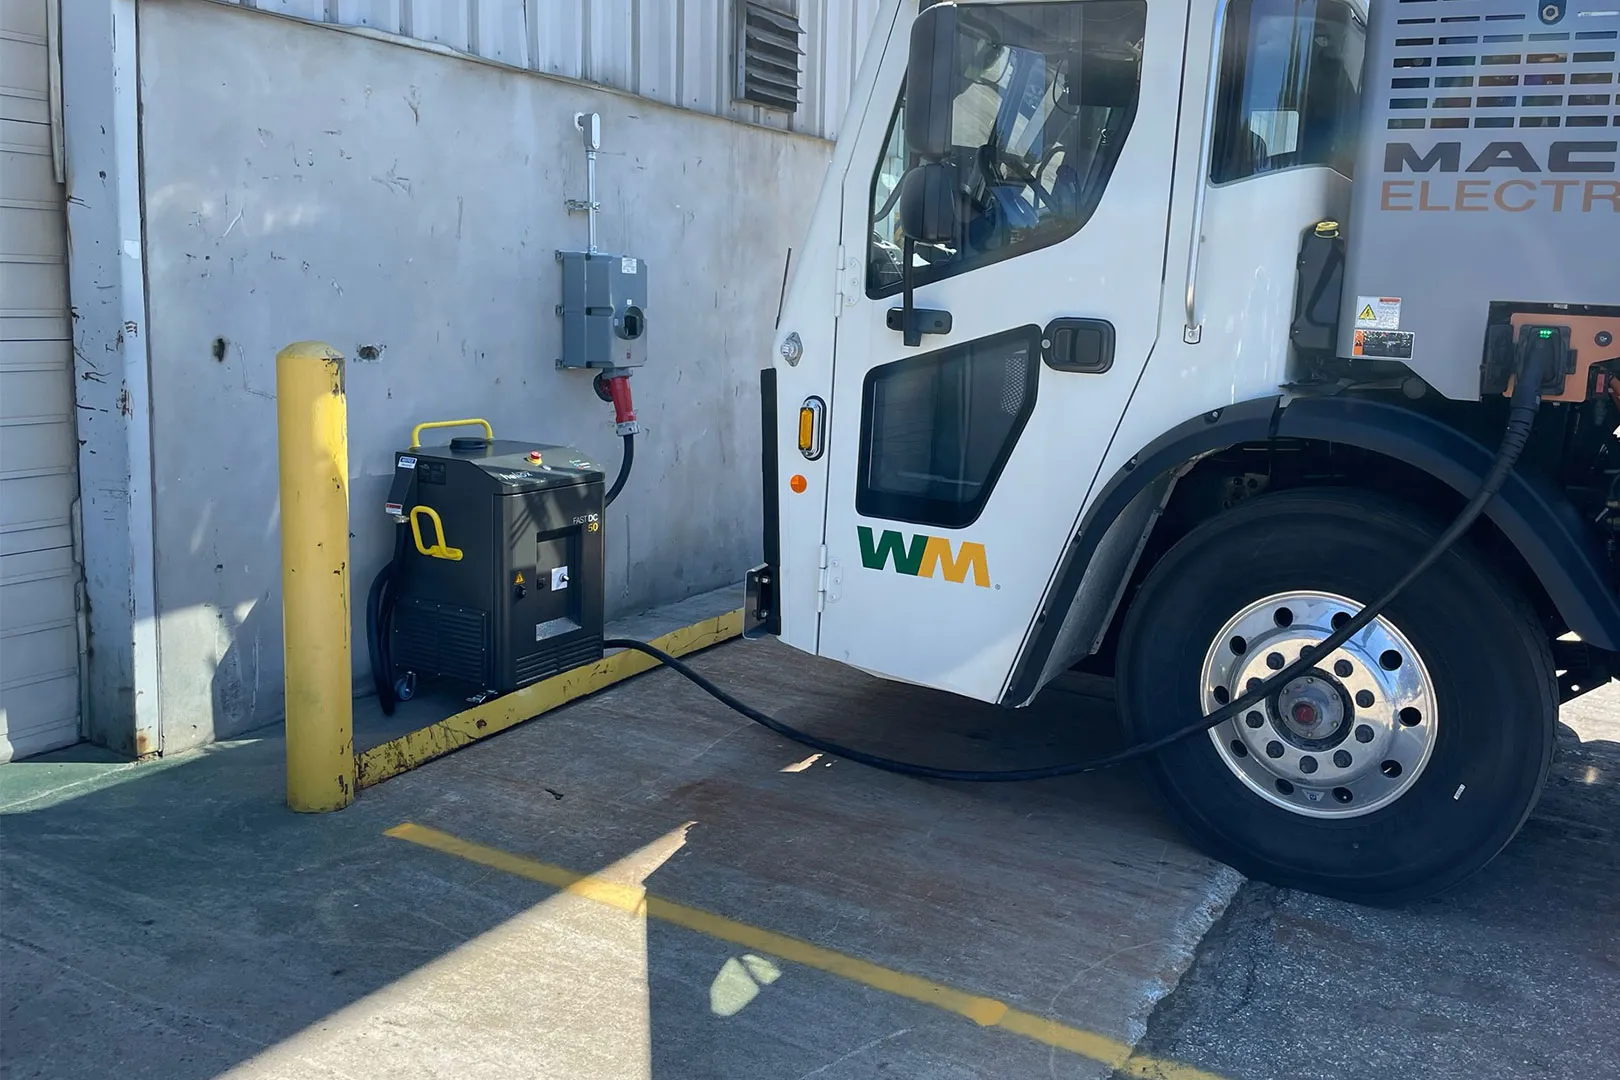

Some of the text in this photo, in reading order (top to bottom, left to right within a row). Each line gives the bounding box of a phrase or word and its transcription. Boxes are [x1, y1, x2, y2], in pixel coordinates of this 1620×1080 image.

[1384, 141, 1618, 173] MAC
[1380, 179, 1620, 213] ELECTR
[572, 513, 599, 525] FAST DC
[587, 522, 599, 533] 50
